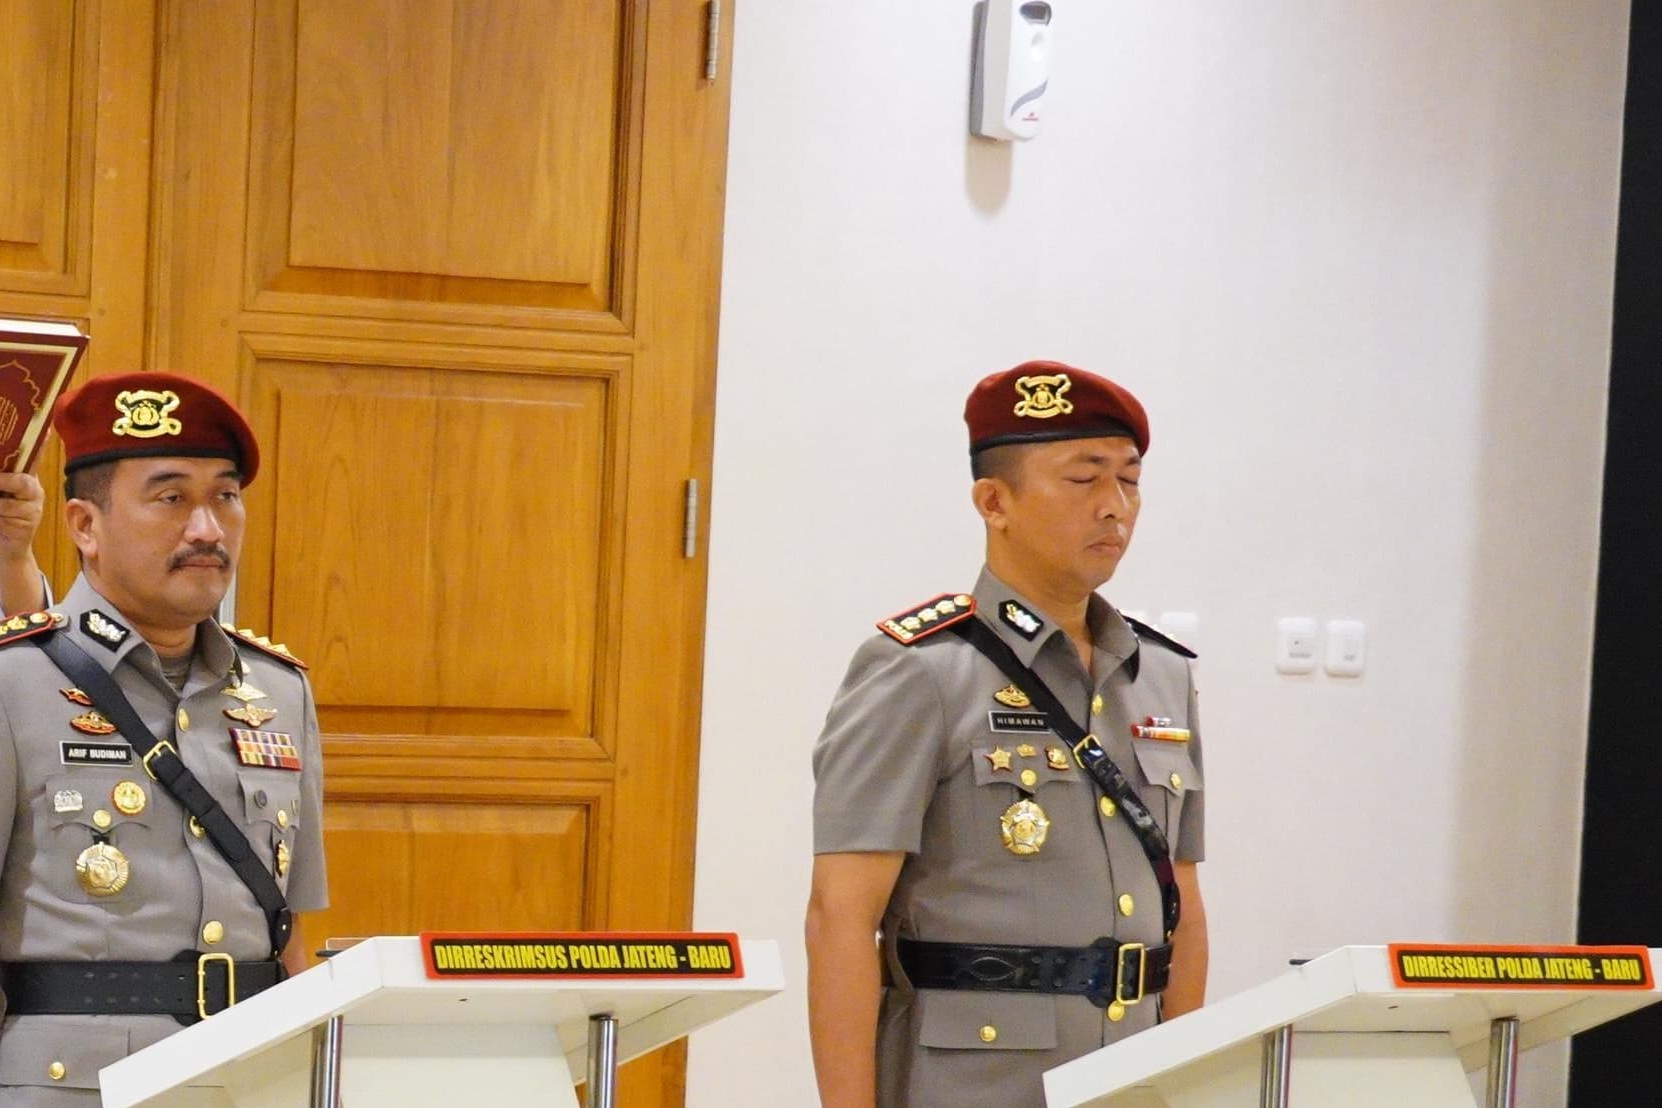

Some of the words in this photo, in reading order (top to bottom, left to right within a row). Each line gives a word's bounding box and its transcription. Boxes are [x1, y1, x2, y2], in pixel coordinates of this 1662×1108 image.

[68, 748, 88, 758] ARIF
[89, 749, 127, 759] BUDIMAN
[434, 945, 567, 968] DIRRESKRIMSUS
[568, 945, 621, 968] POLDA
[622, 945, 677, 968] JATENG
[687, 945, 731, 968] BARU
[1402, 955, 1496, 978] DIRRESSIBER
[1498, 957, 1543, 980] POLDA
[1543, 958, 1594, 980] JATENG
[1602, 959, 1641, 980] BARU
